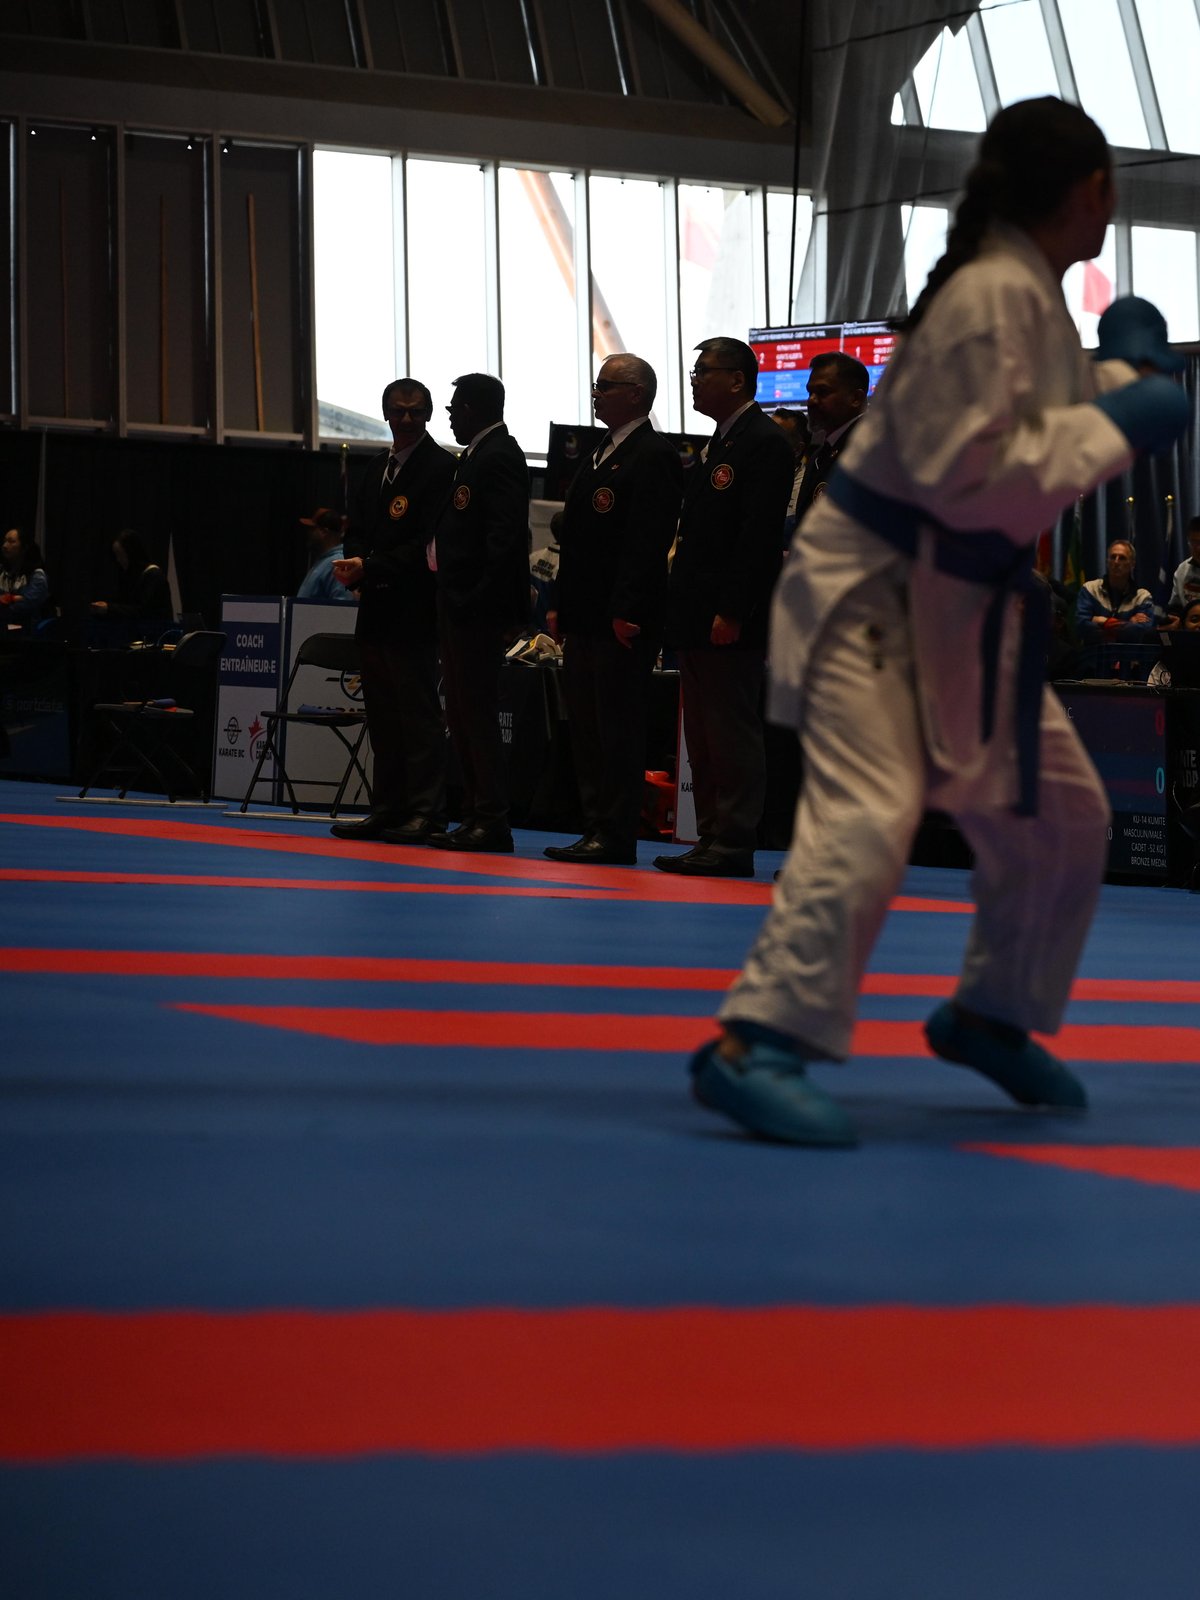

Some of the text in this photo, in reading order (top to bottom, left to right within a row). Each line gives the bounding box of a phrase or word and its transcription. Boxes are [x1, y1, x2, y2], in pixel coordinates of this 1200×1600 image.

[236, 634, 264, 649] COACH
[219, 747, 238, 759] KARATE
[1156, 767, 1165, 794] 0
[1131, 842, 1147, 852] CADET
[1131, 856, 1150, 867] BRONZE
